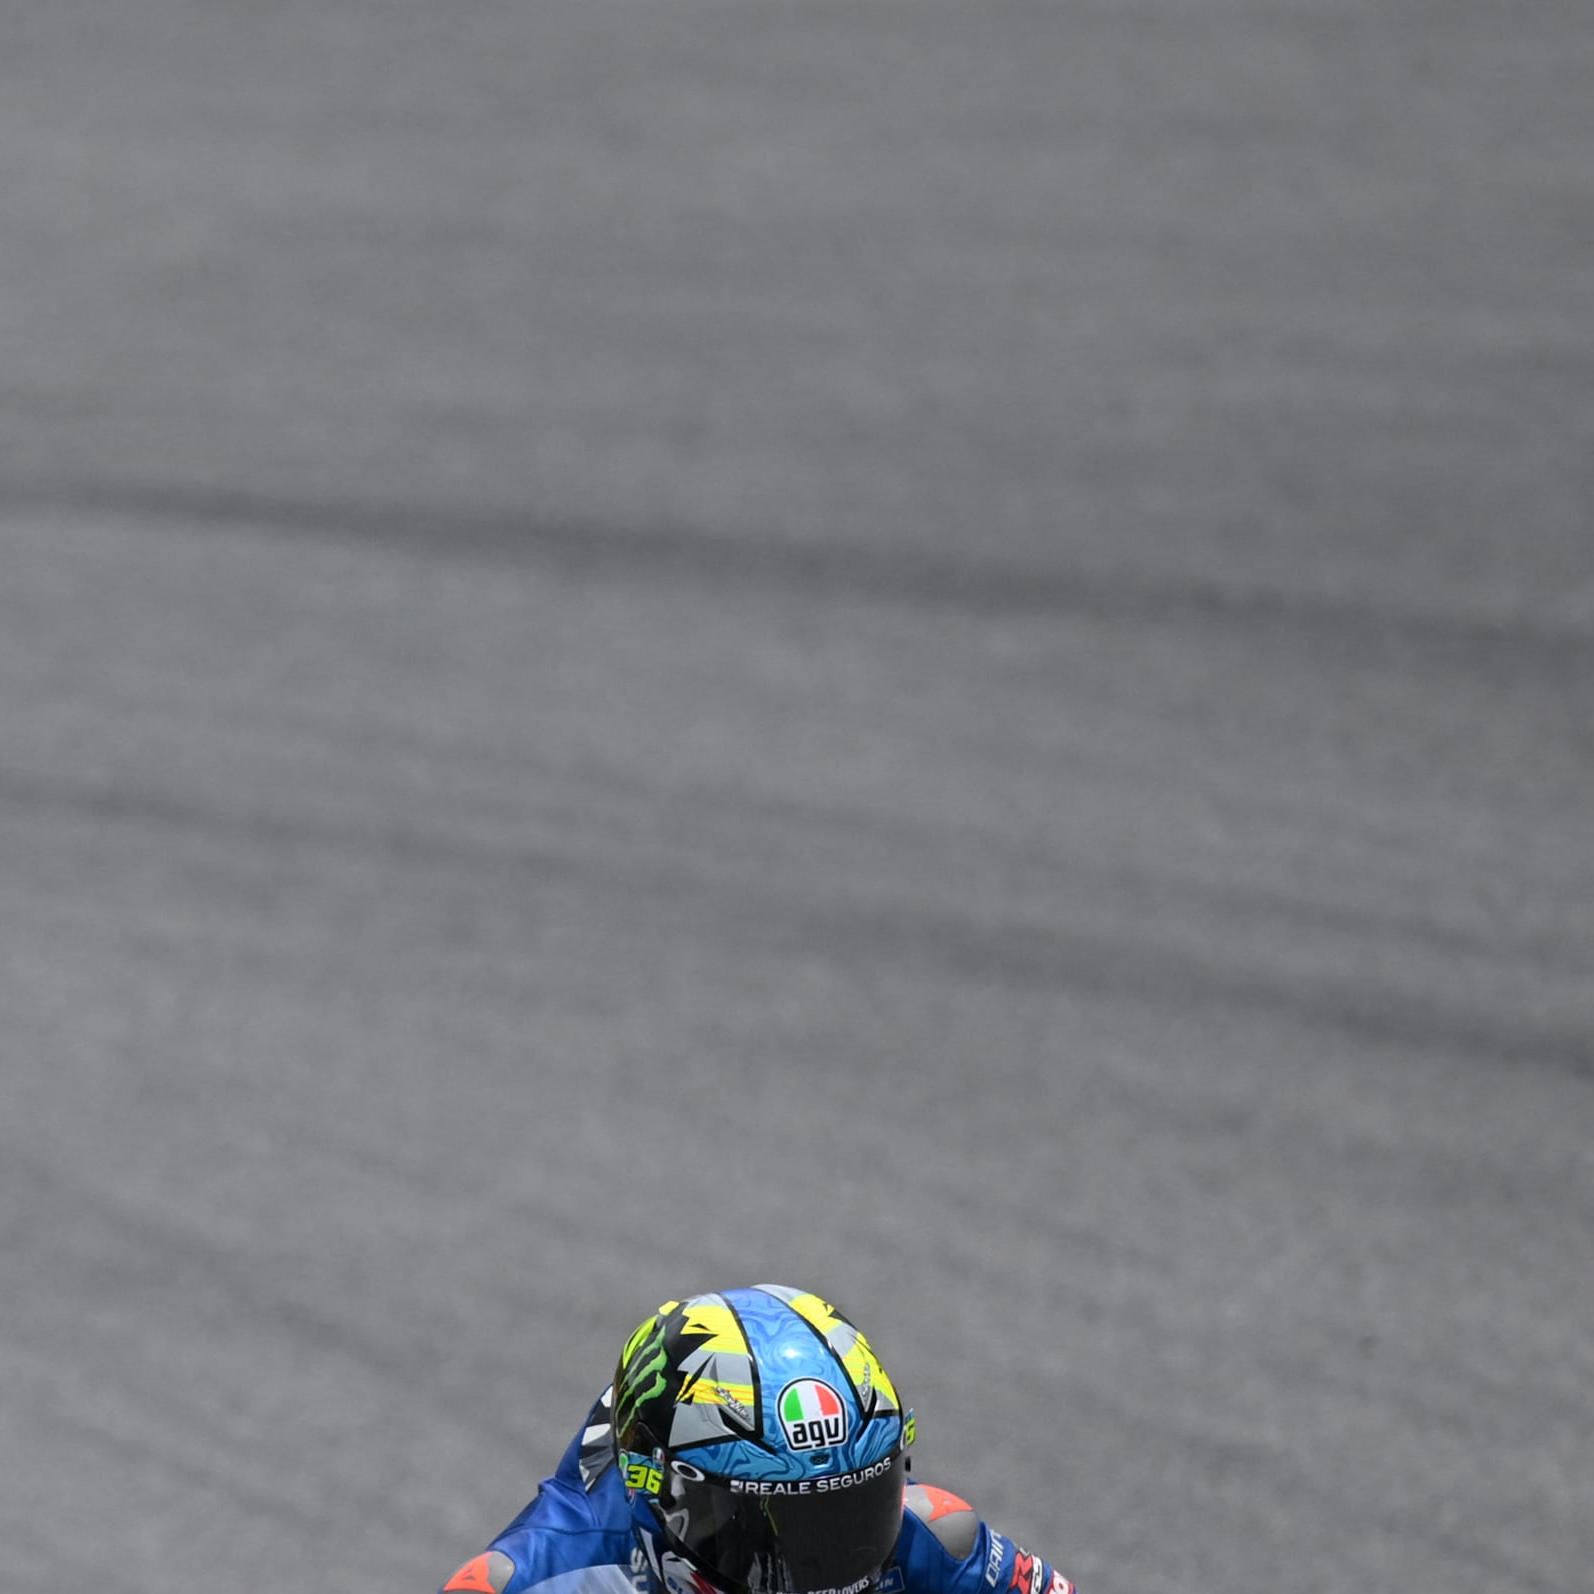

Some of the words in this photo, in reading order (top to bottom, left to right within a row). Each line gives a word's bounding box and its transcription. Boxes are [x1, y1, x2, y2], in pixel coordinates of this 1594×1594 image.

[792, 1418, 840, 1448] agv
[625, 1463, 663, 1494] 36
[745, 1480, 811, 1495] REALE
[816, 1457, 891, 1492] SEGUROS
